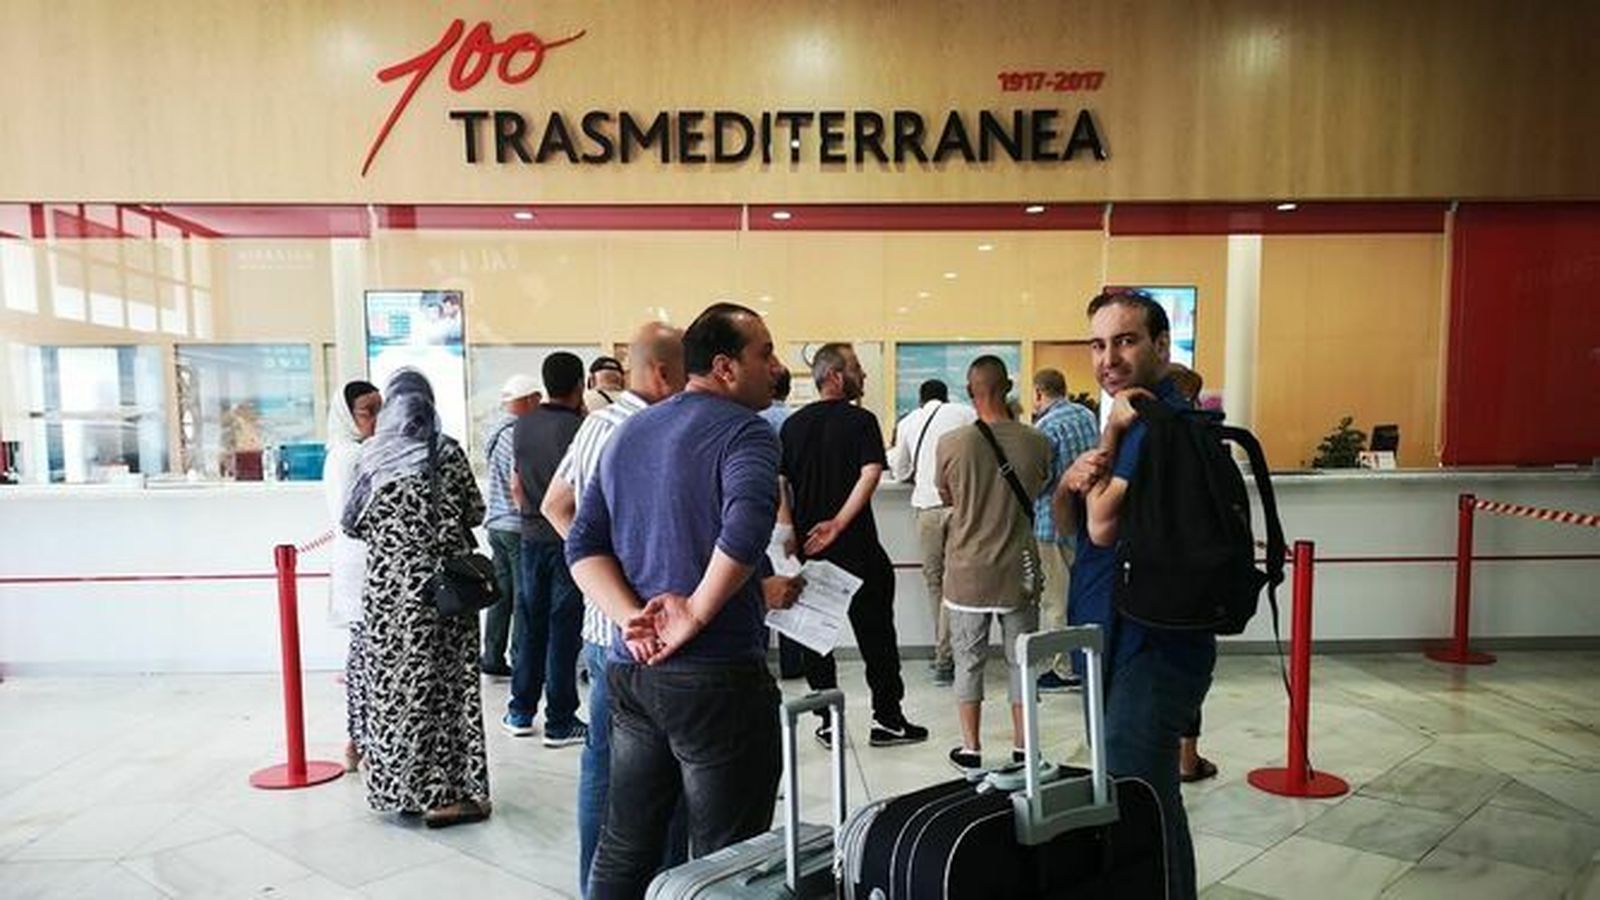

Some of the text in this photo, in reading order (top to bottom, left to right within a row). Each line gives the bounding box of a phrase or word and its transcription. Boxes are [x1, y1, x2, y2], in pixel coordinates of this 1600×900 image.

[362, 19, 587, 177] 100
[998, 71, 1105, 92] 1917-2017
[450, 110, 1107, 163] TRASMEDITERRANEA
